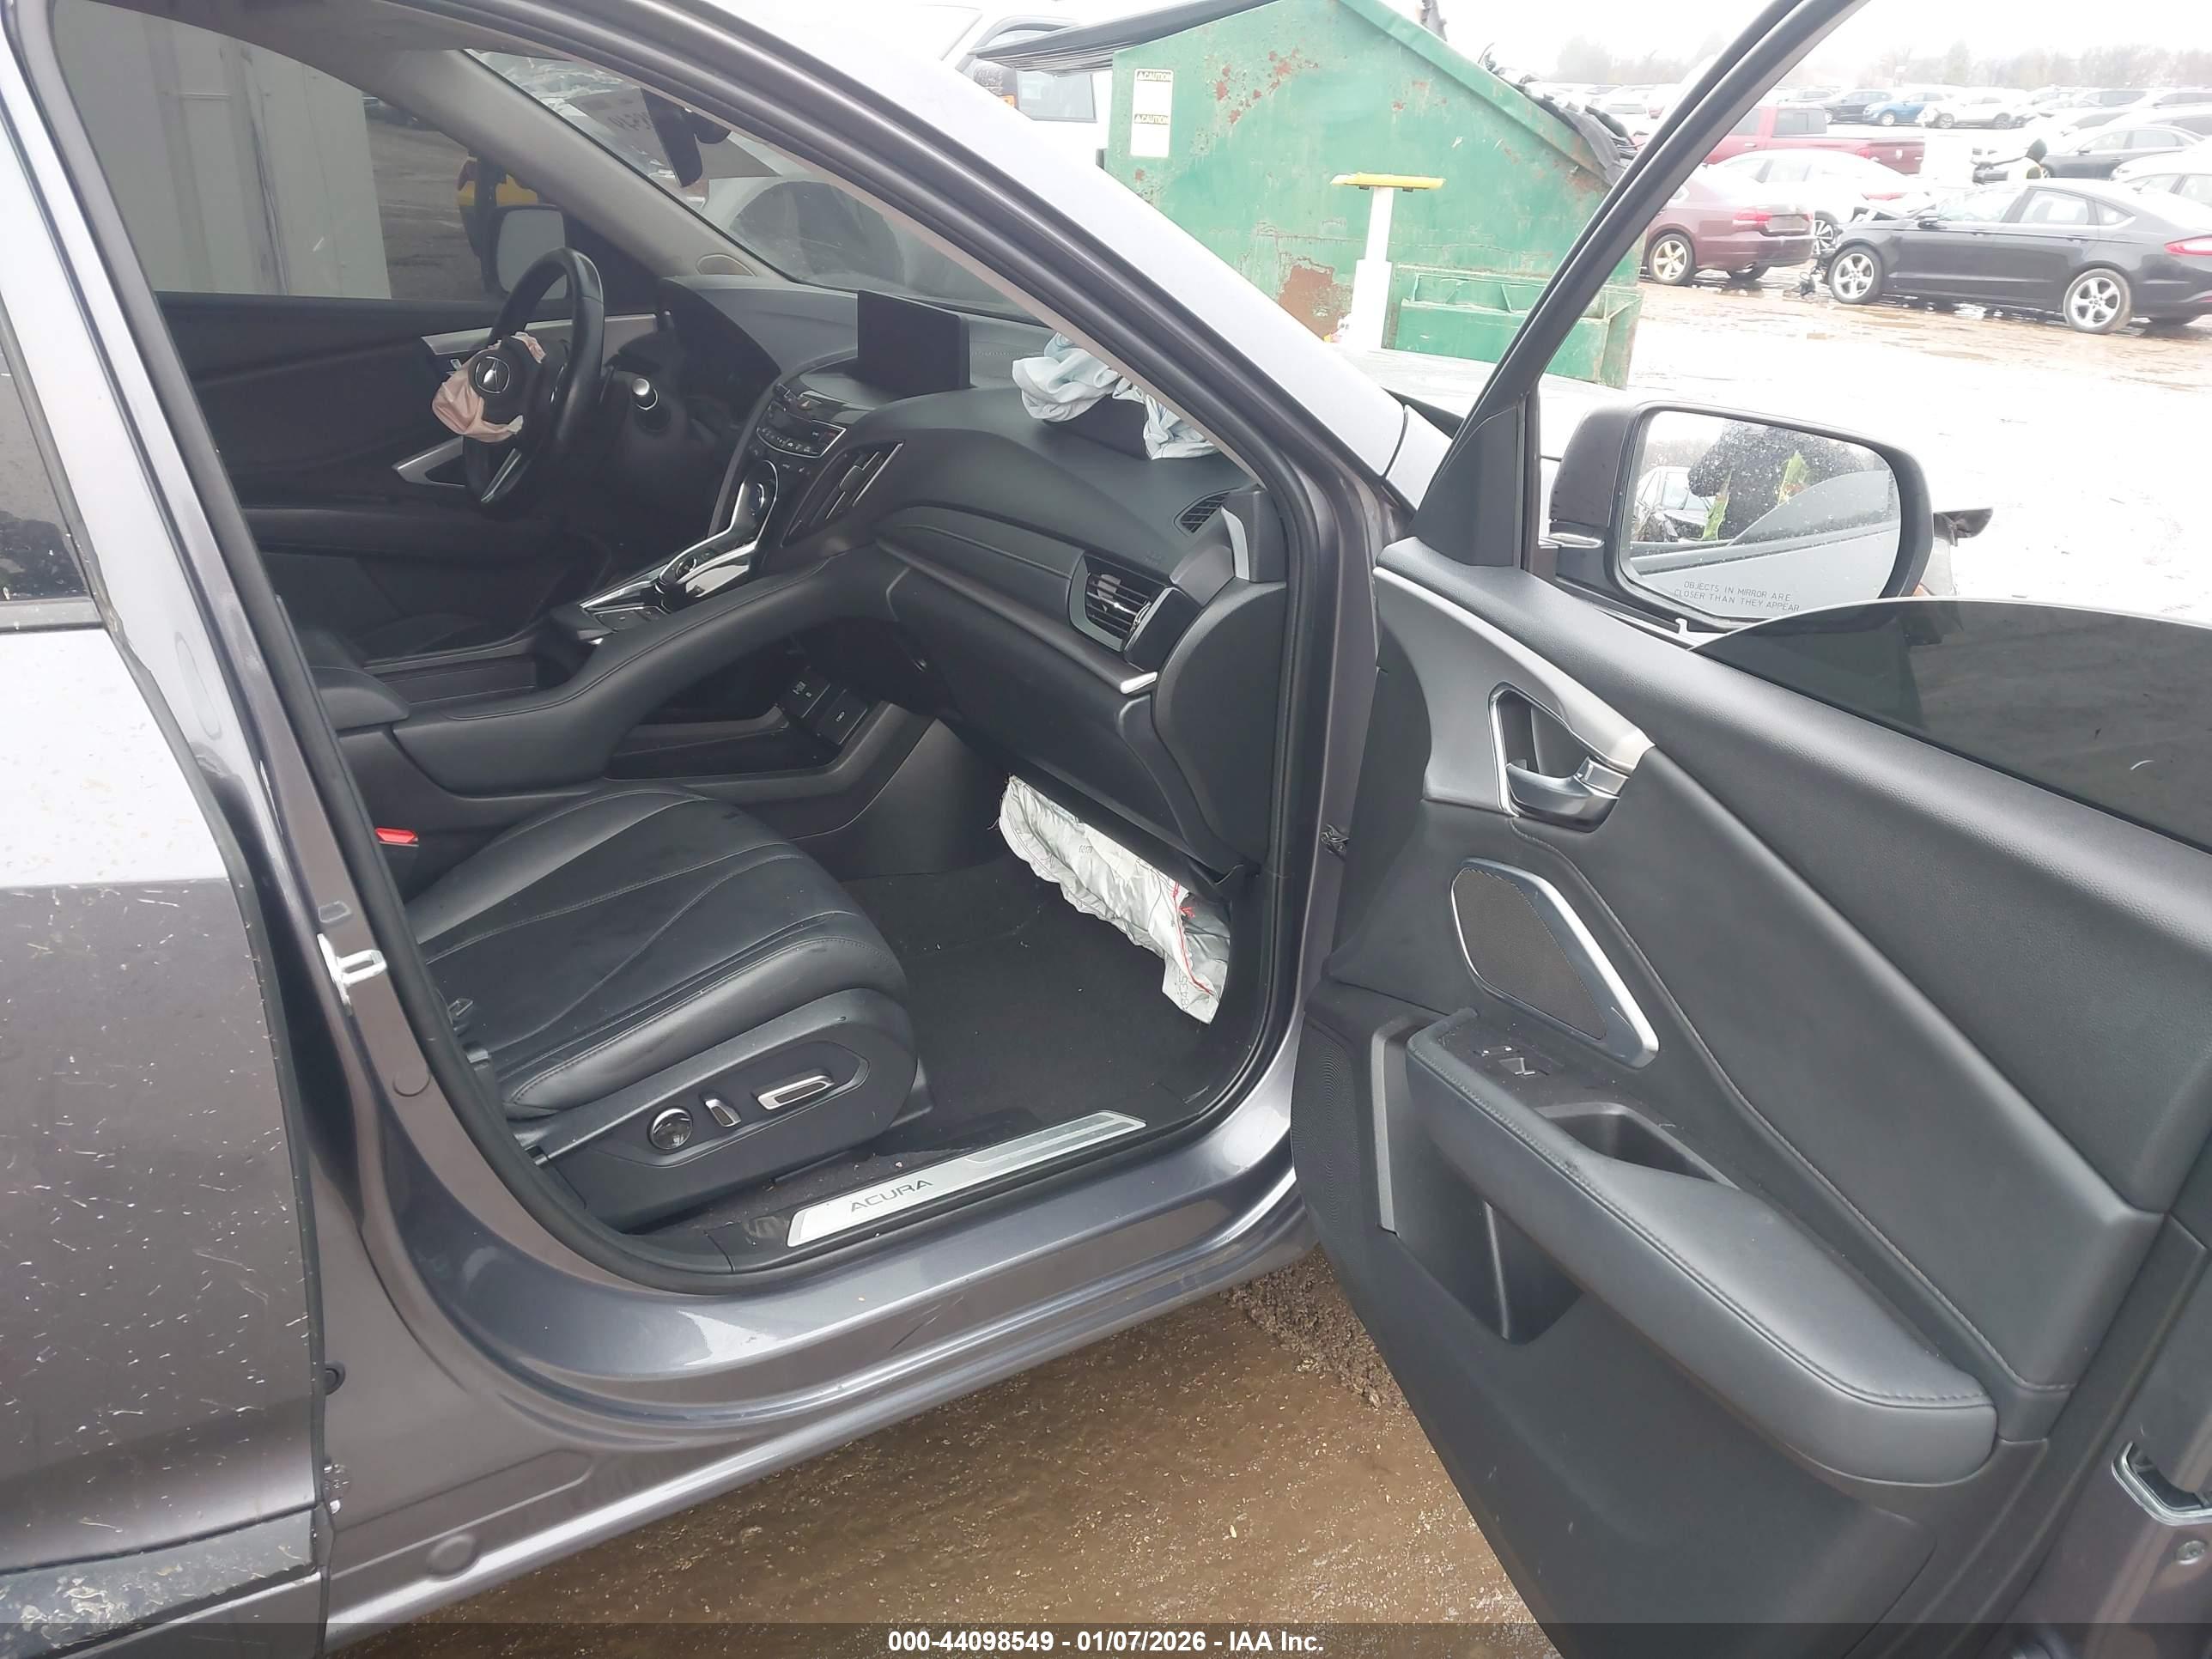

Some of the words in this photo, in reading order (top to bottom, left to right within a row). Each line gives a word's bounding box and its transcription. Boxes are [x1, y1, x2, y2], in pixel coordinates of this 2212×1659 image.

[1144, 71, 1171, 82] CAUTION
[1141, 114, 1169, 125] CAUTION
[1674, 588, 1705, 600] CLOSER
[1710, 593, 1735, 604] THAN
[1741, 598, 1764, 608] THEY
[1765, 601, 1800, 611] APPEAR
[1684, 580, 1719, 592] OBJECTS
[1724, 585, 1735, 594] IN
[1737, 588, 1767, 598] MIRROR
[1771, 592, 1791, 602] ARE
[851, 1180, 933, 1212] ACURA
